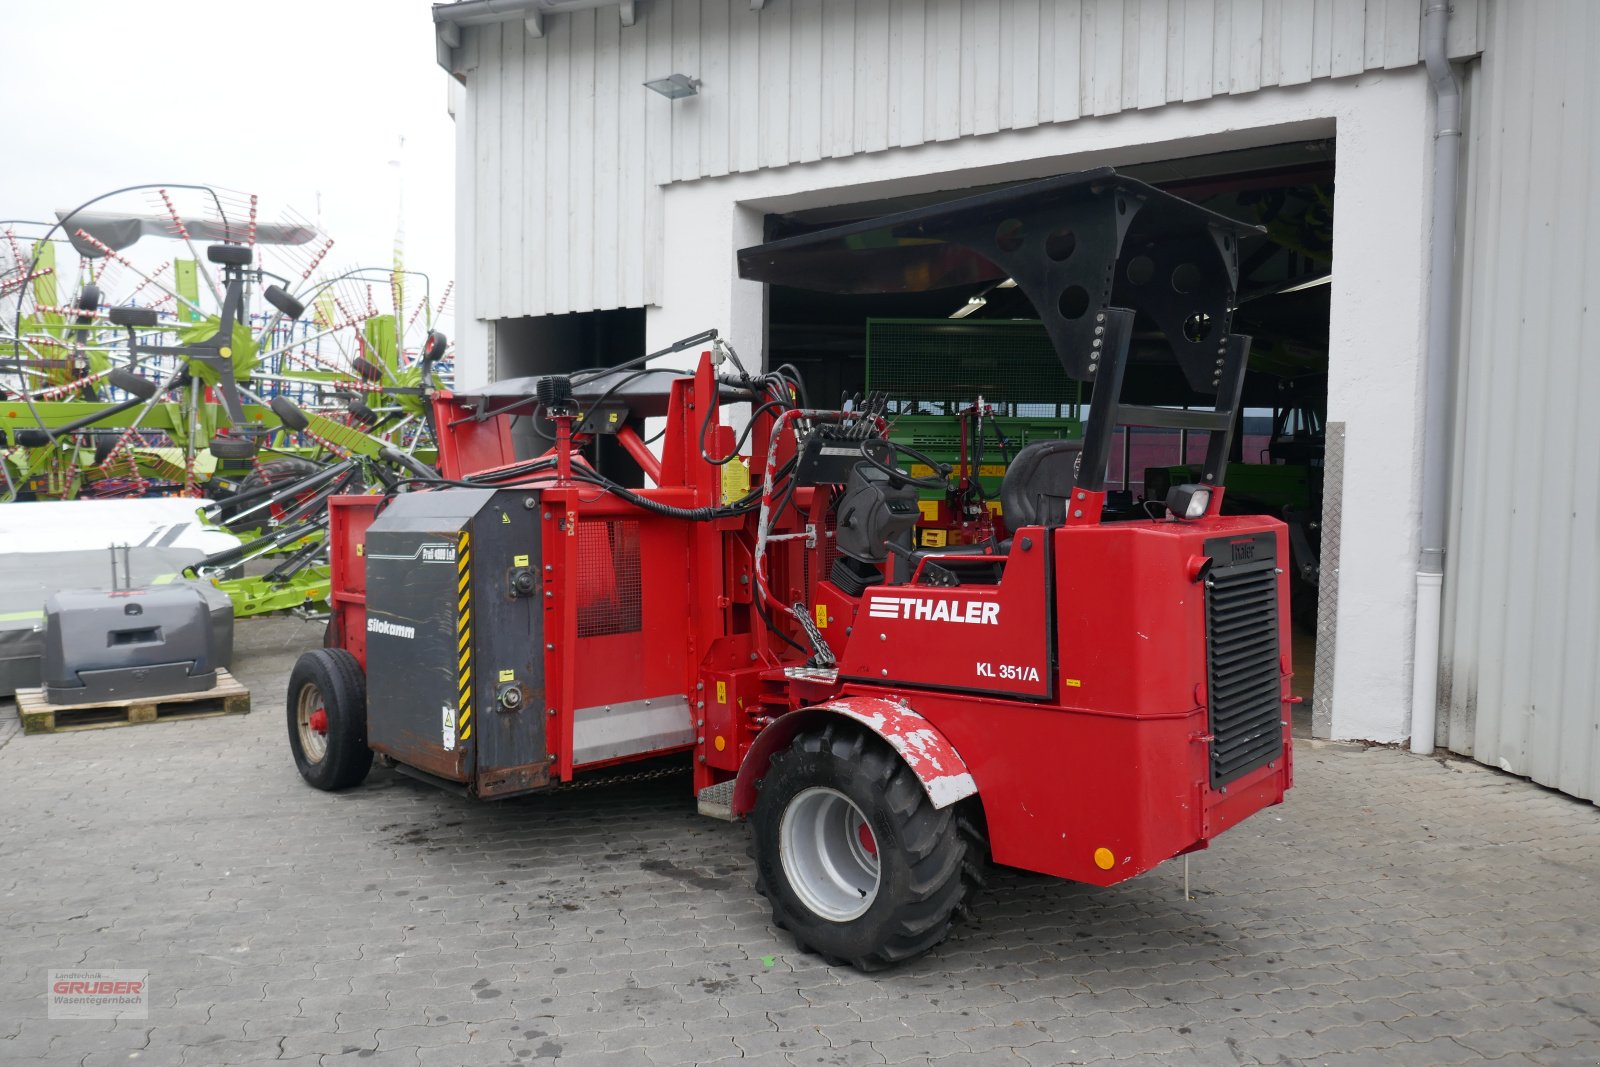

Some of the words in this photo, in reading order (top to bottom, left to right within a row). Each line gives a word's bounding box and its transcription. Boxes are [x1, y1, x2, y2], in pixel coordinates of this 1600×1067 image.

[900, 598, 1001, 625] THALER
[976, 662, 996, 678] KL
[999, 664, 1040, 682] 351/A
